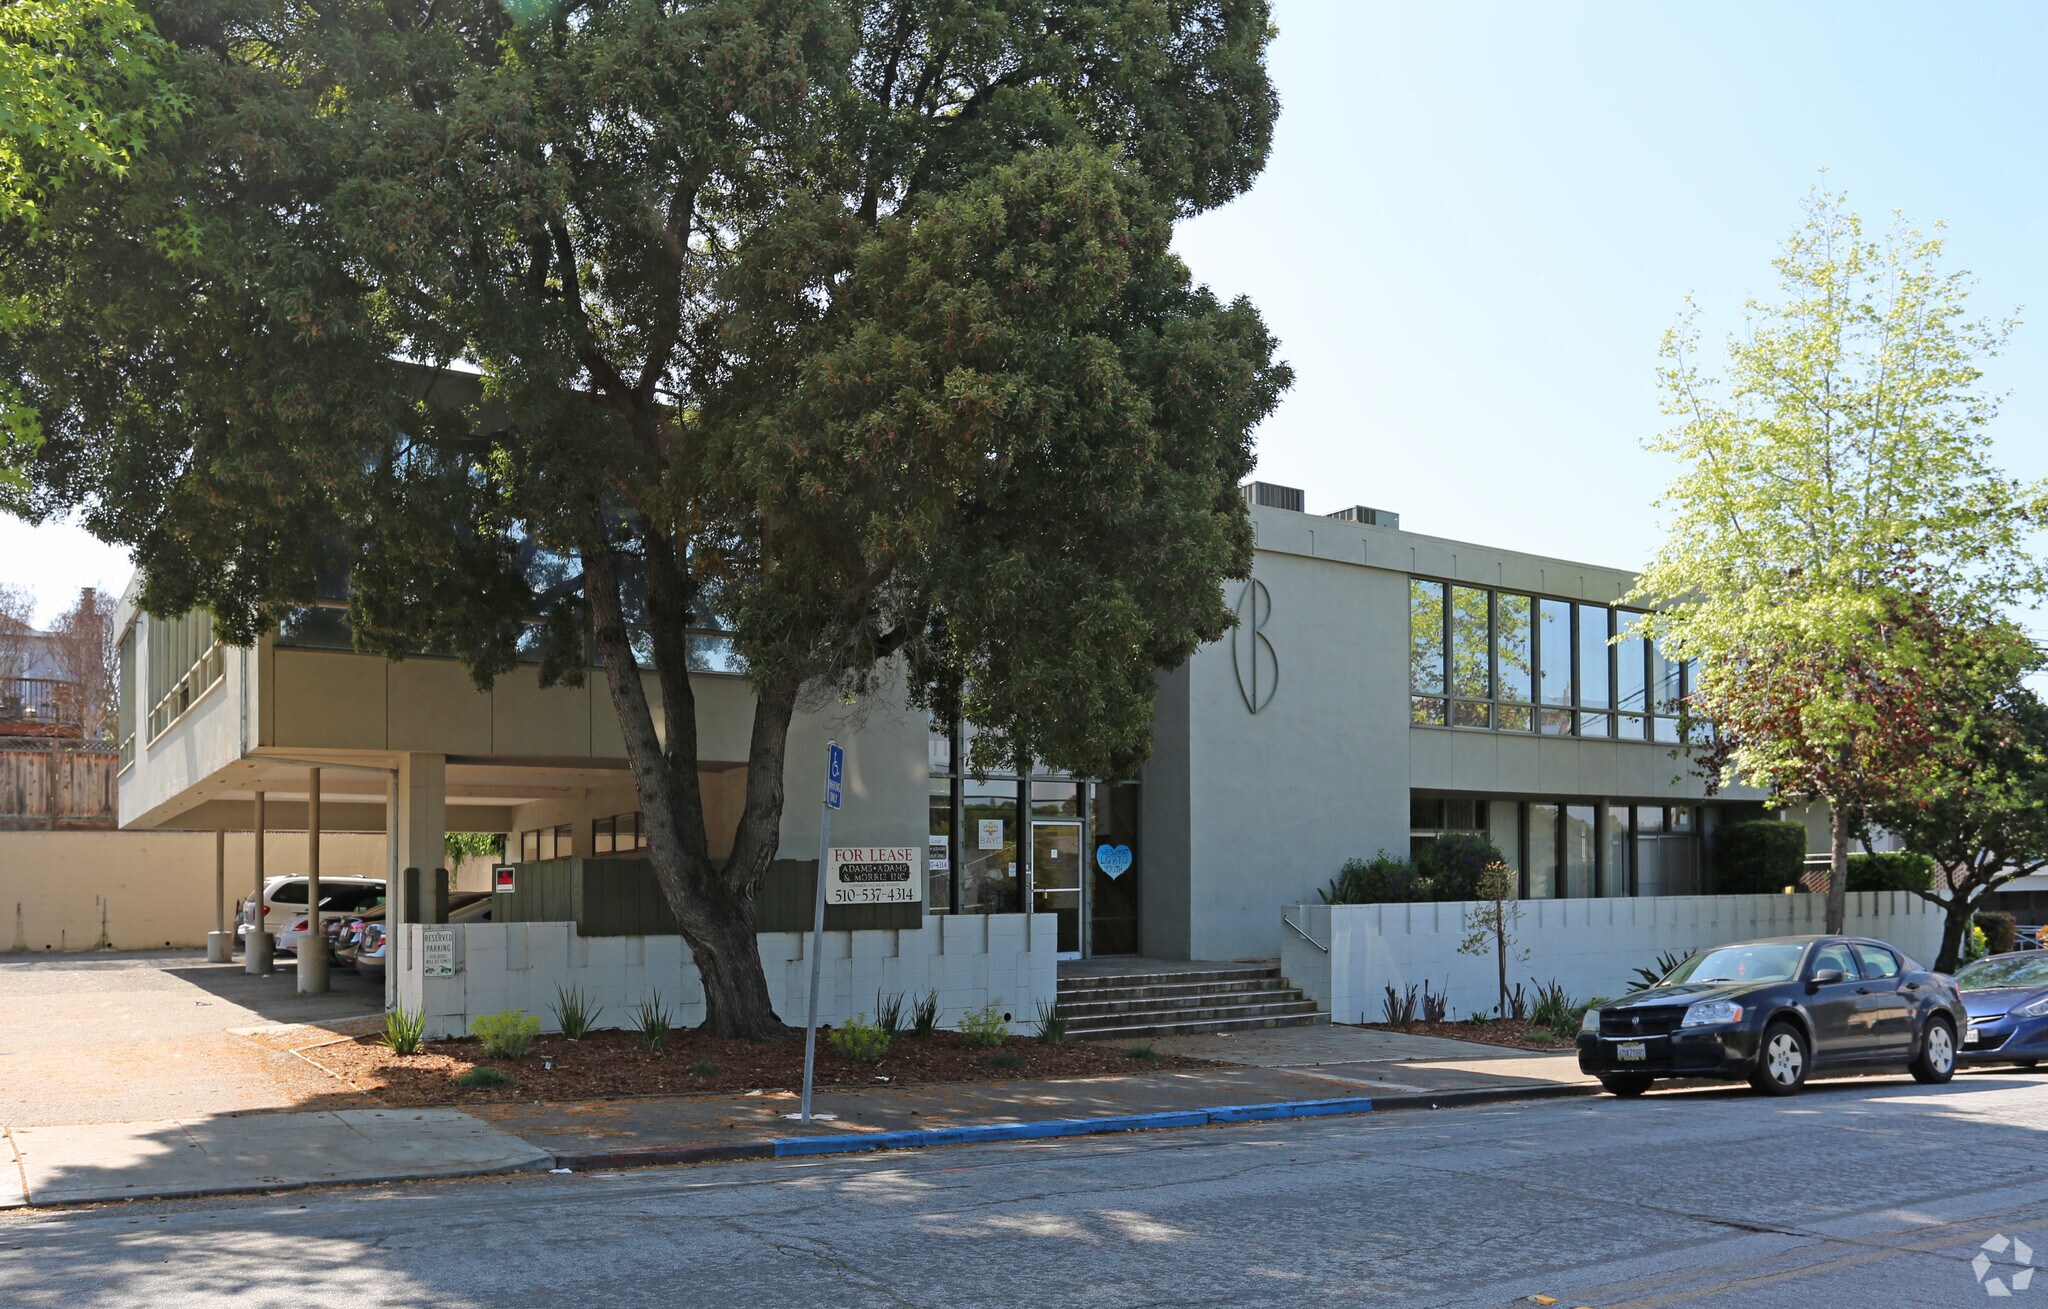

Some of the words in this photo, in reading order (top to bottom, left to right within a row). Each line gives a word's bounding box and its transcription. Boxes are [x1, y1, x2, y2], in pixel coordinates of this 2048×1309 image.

[980, 836, 1002, 845] BAYC
[834, 848, 864, 862] FOR
[869, 848, 913, 861] LEASE
[1104, 865, 1123, 873] YOUTH
[854, 872, 887, 881] MORRIS
[835, 888, 914, 902] 510-537-4314
[424, 934, 453, 942] RESERVED
[426, 944, 451, 952] PARKING
